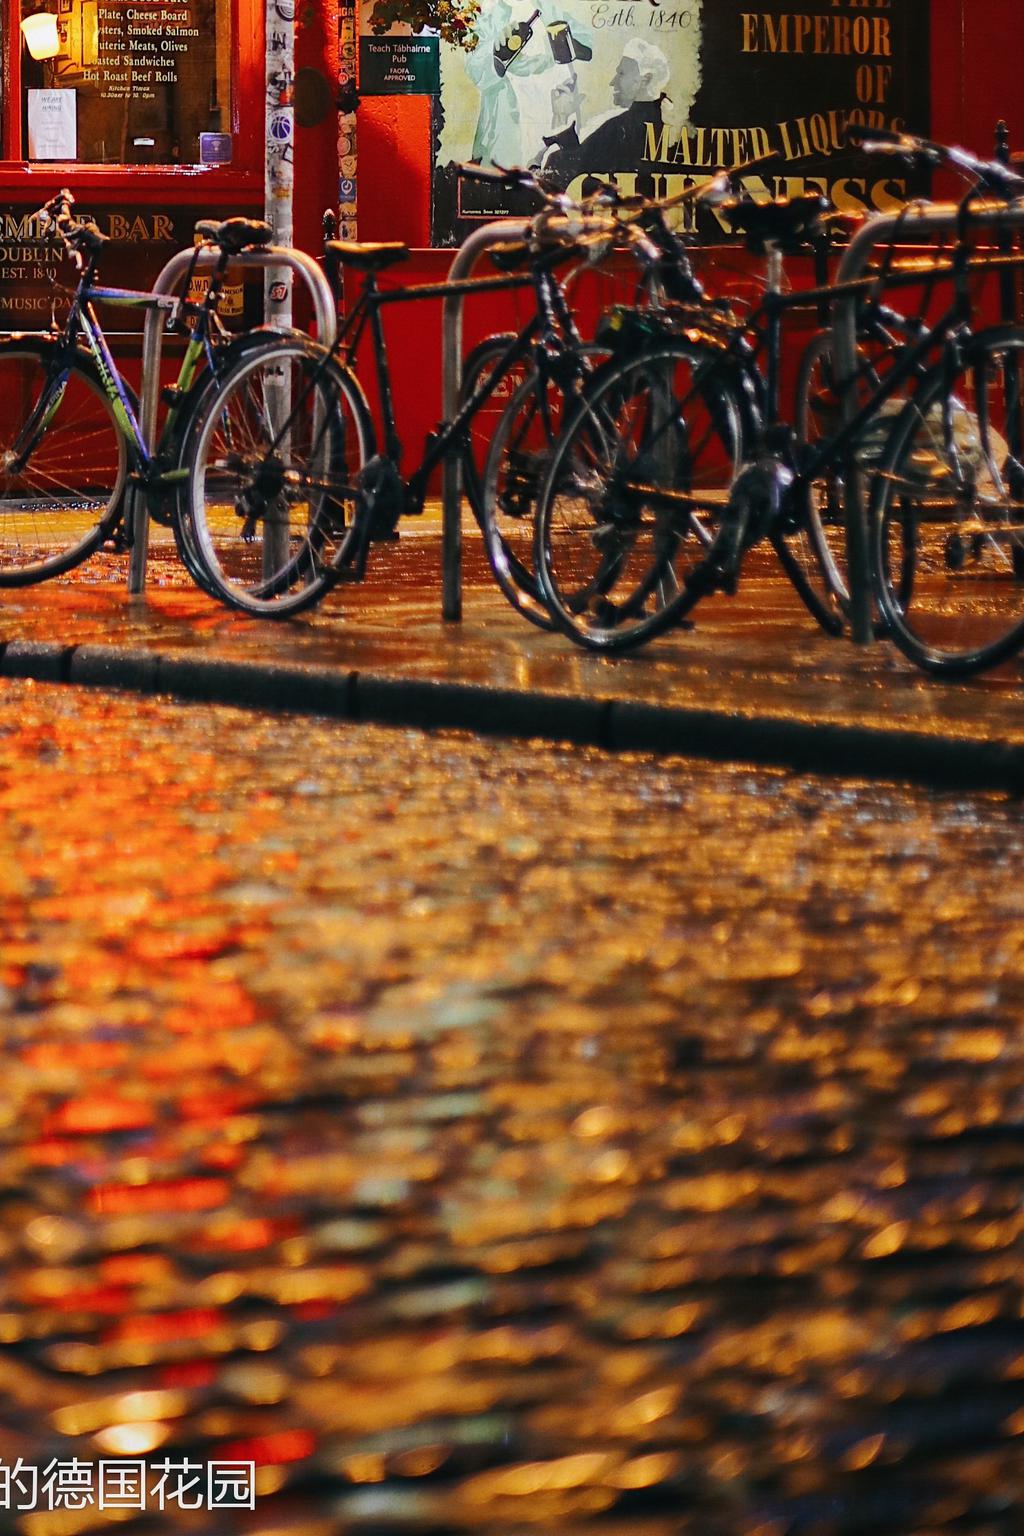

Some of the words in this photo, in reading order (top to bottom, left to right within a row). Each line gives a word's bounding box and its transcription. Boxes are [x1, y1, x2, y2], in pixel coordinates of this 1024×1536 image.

[98, 9, 124, 22] Plate,
[126, 9, 158, 21] Cheese
[160, 10, 188, 21] Board
[647, 8, 693, 31] 1840
[93, 26, 124, 37] ysters,
[127, 24, 163, 36] Smoked
[165, 25, 200, 37] Salmon
[740, 13, 893, 57] EMPEROR
[128, 39, 159, 52] Meats,
[160, 40, 189, 52] Olives
[368, 44, 391, 53] Teach
[392, 44, 431, 53] Tábhairne
[123, 55, 175, 67] Sandwiches
[392, 54, 407, 63] Pub
[82, 70, 100, 81] Hot
[103, 70, 128, 81] Roast
[131, 70, 153, 82] Beef
[155, 71, 178, 82] Rolls
[855, 64, 893, 104] OF
[640, 121, 771, 168] MALTED
[107, 213, 177, 242] BAR
[1, 267, 28, 279] EST.
[0, 297, 48, 311] MUSIC
